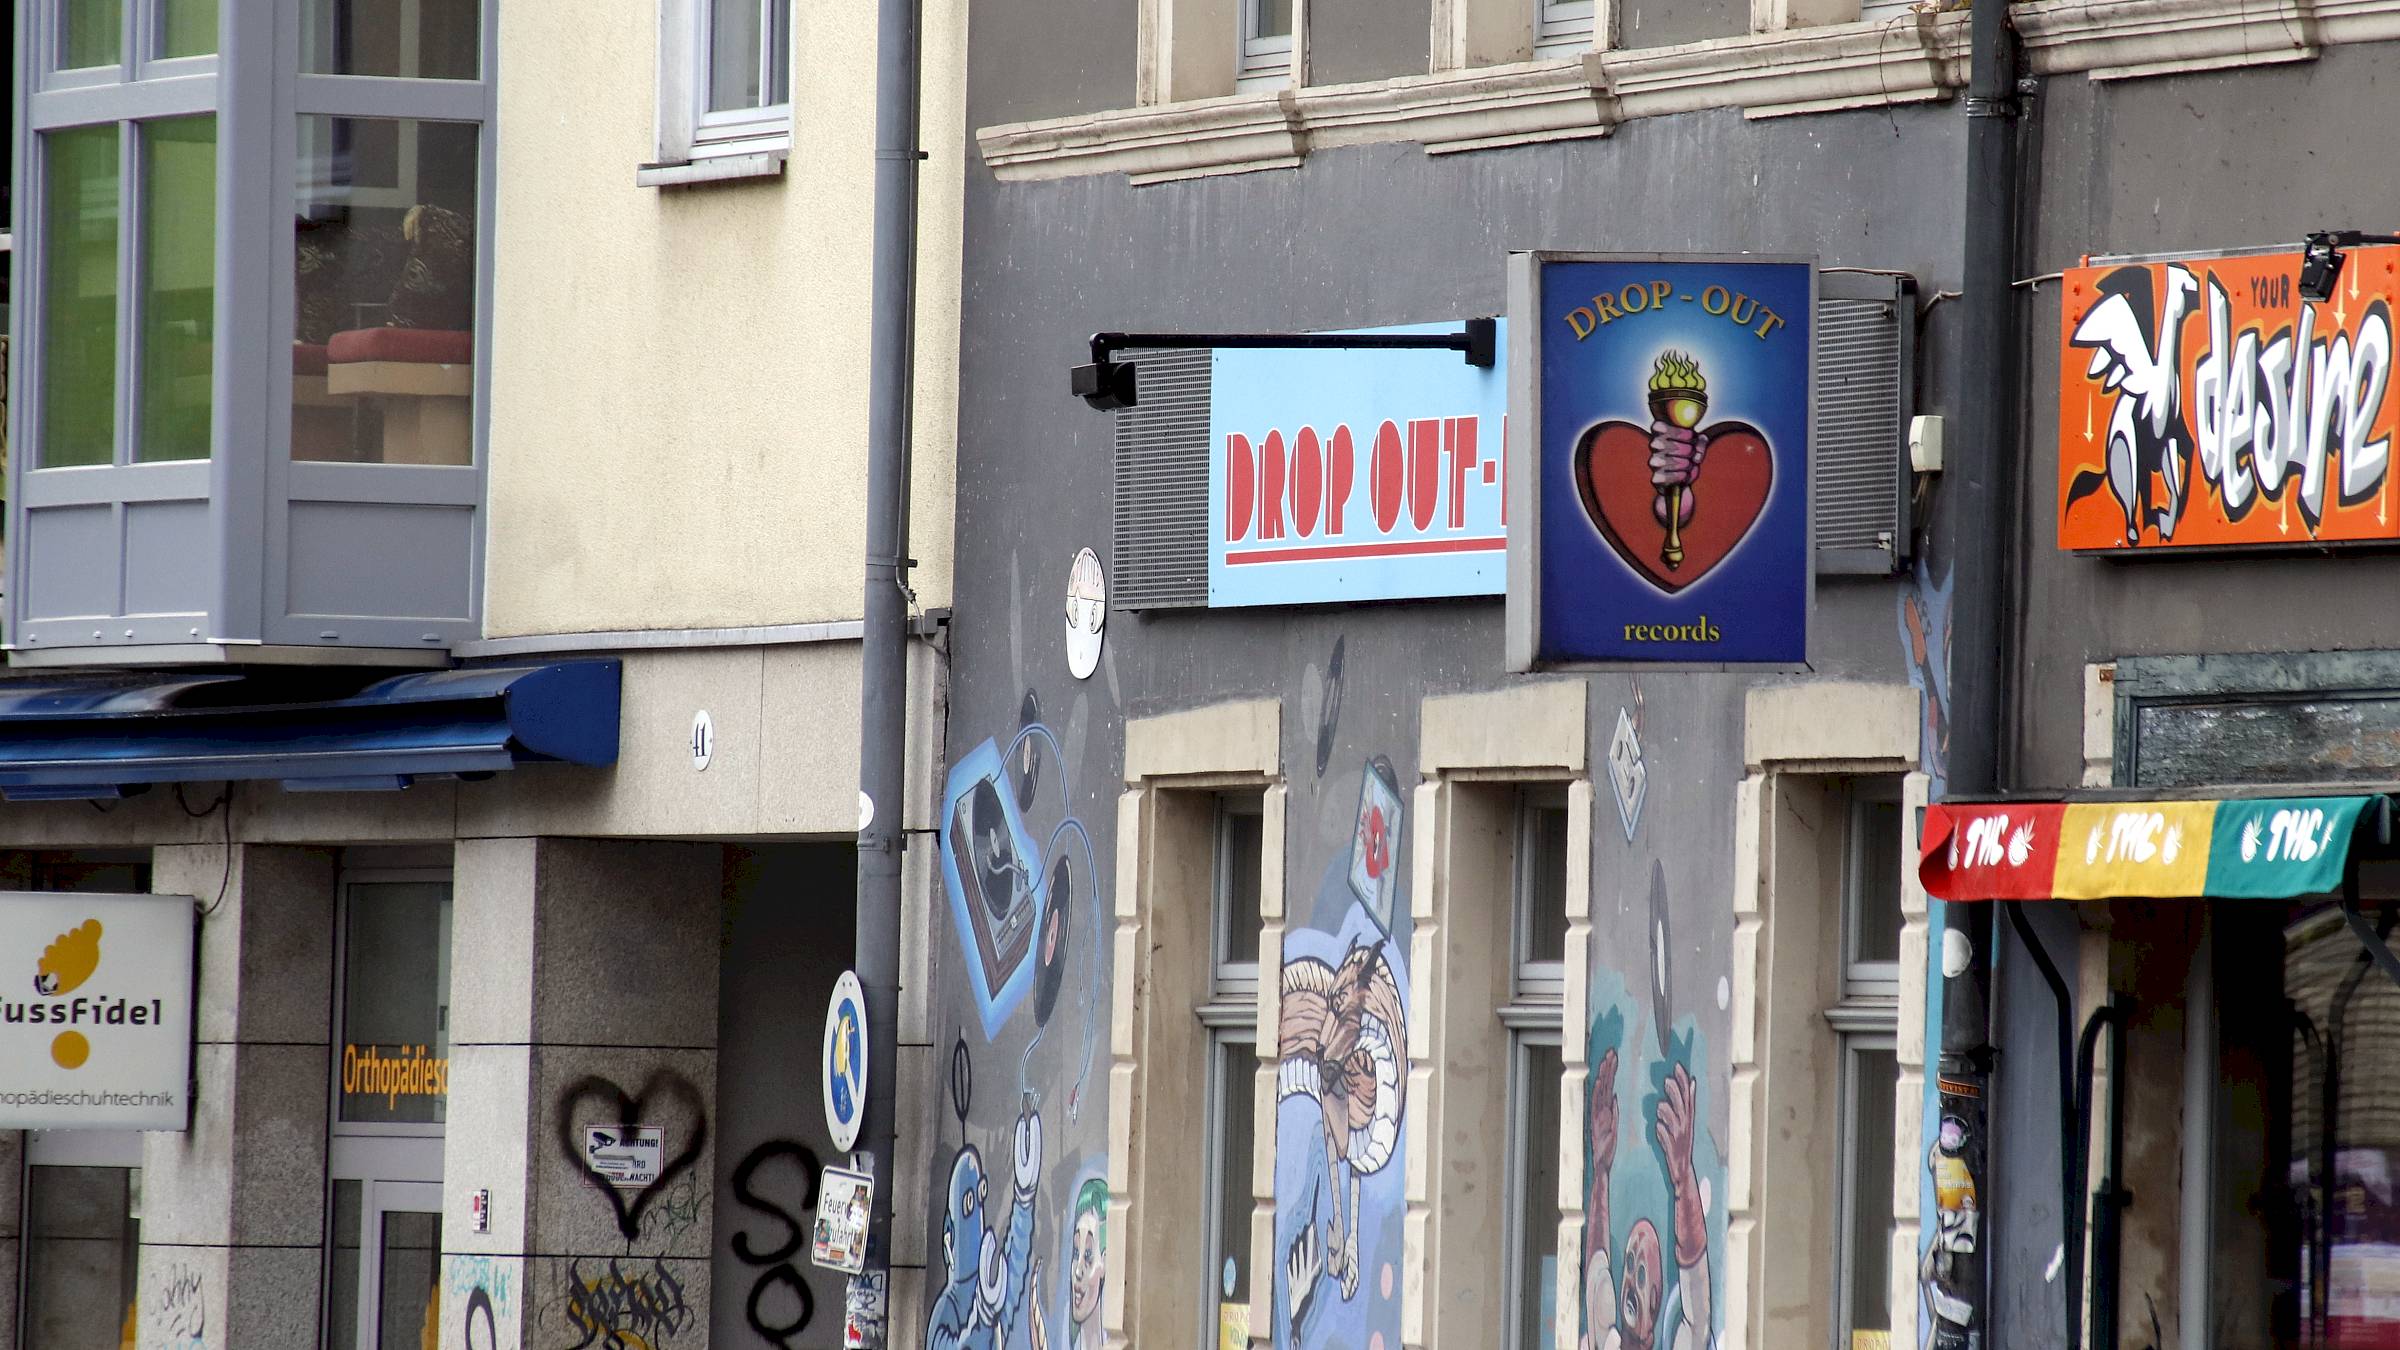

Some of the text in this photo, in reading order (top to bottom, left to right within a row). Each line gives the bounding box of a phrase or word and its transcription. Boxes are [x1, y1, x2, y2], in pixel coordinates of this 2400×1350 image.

[2251, 273, 2290, 309] YOUR
[1225, 415, 1507, 543] DROP OUT-
[1624, 616, 1720, 641] records
[0, 996, 161, 1025] ussFidel
